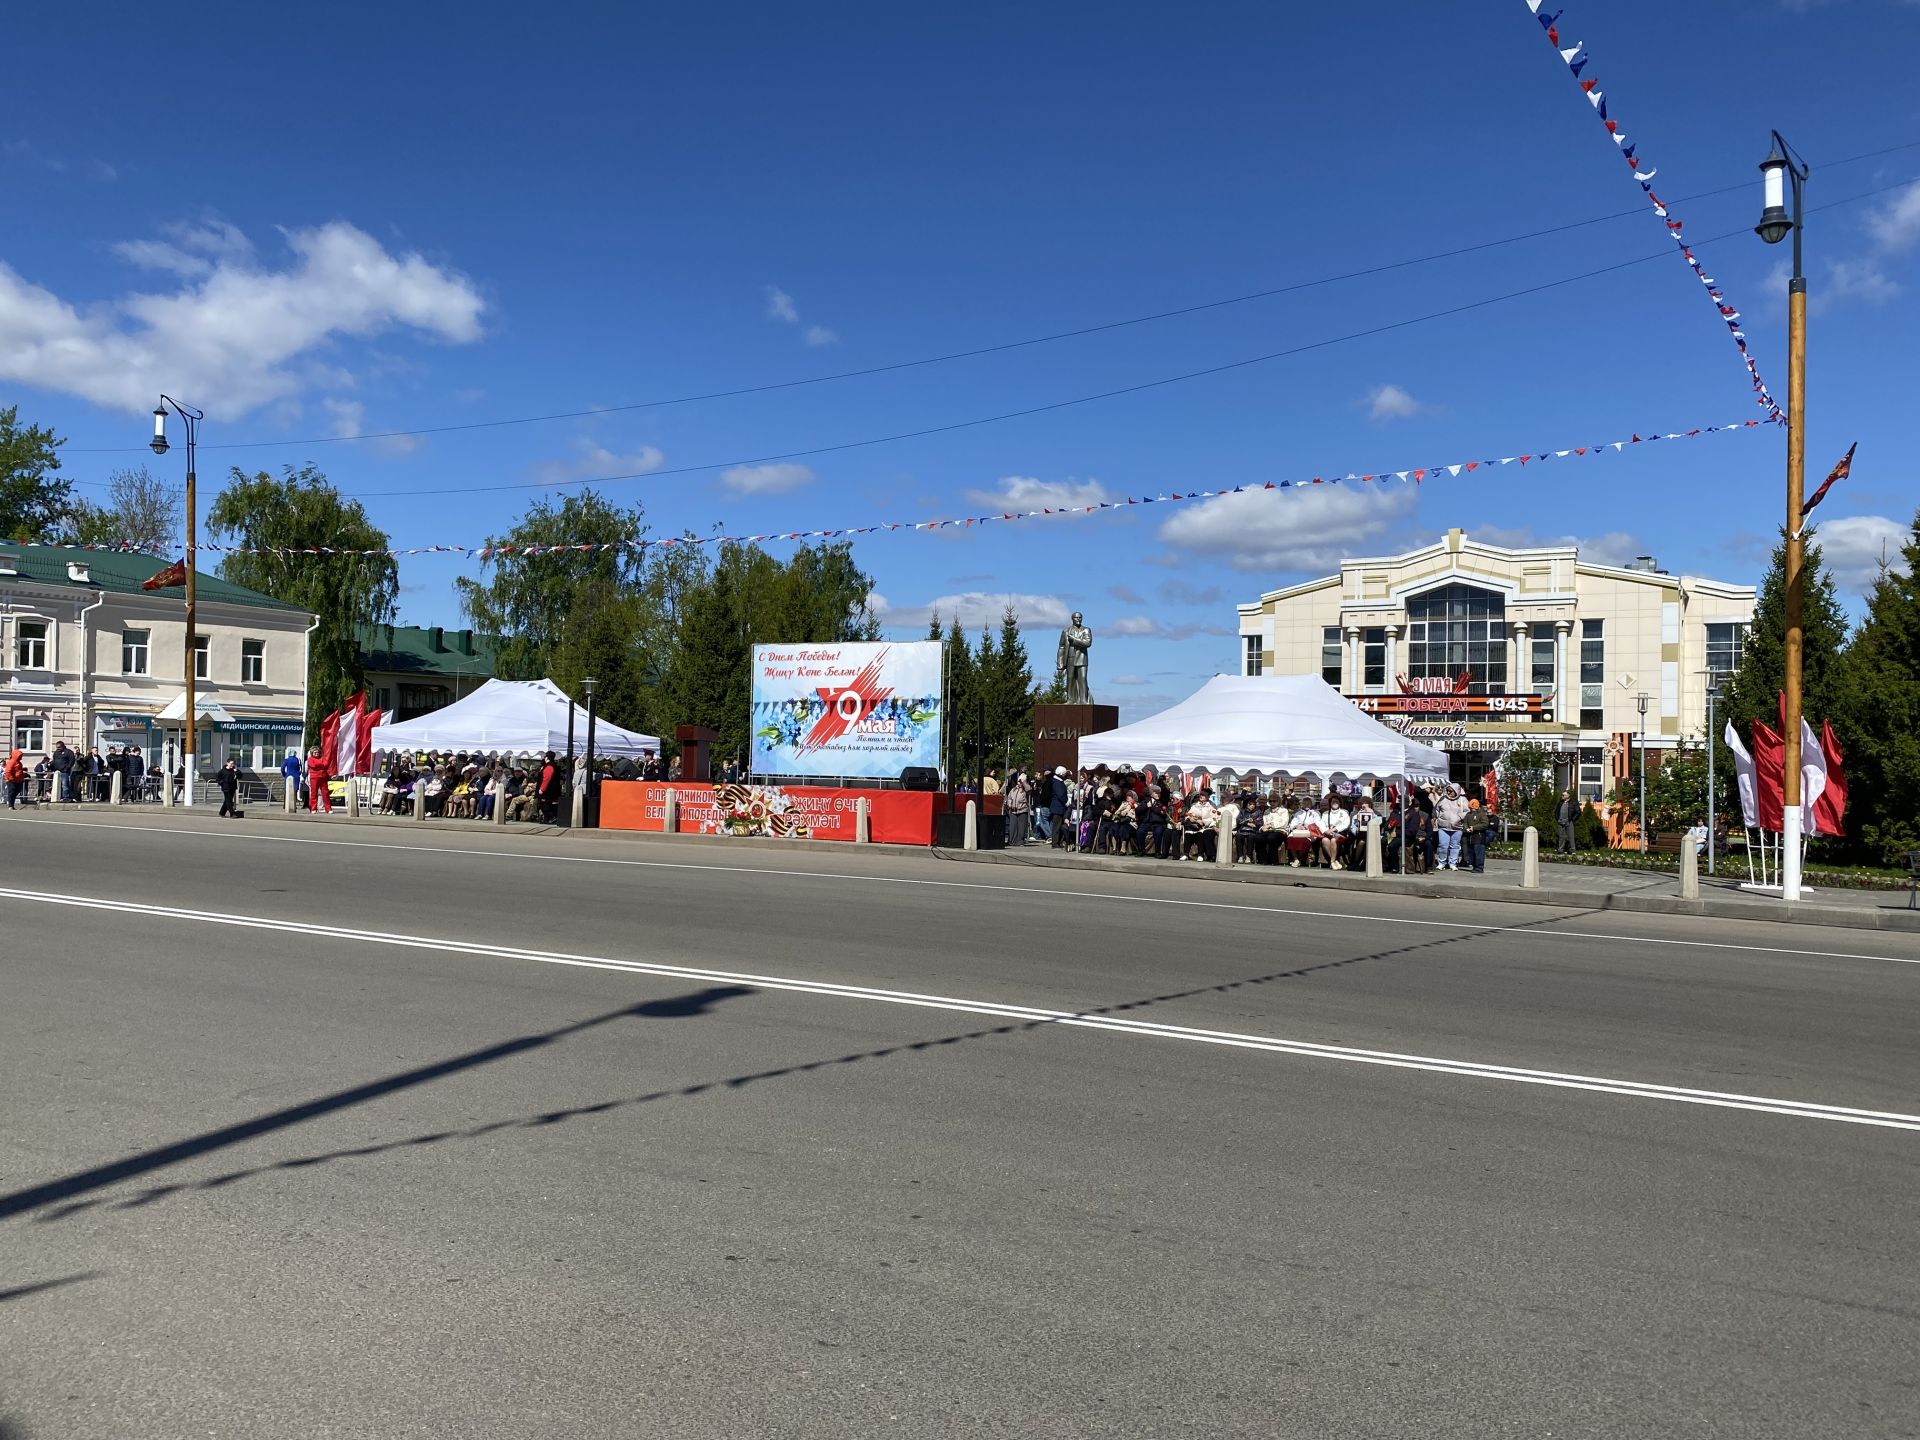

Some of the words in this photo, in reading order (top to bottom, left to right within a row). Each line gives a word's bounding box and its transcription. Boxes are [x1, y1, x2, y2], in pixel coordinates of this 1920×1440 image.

[759, 652, 765, 661] С
[768, 652, 794, 661] Днем
[796, 650, 841, 661] Победы!
[1413, 677, 1421, 692] 9
[1422, 677, 1452, 692] МАЯ
[837, 690, 862, 735] 9
[857, 719, 896, 734] мая
[1397, 698, 1468, 713] ПОБЕДА!
[1486, 697, 1529, 711] 1945
[1038, 726, 1087, 740] ЛЕНИН
[1391, 716, 1467, 737] Чистай
[646, 788, 653, 801] С
[784, 813, 840, 829] РӘХМӘТ!
